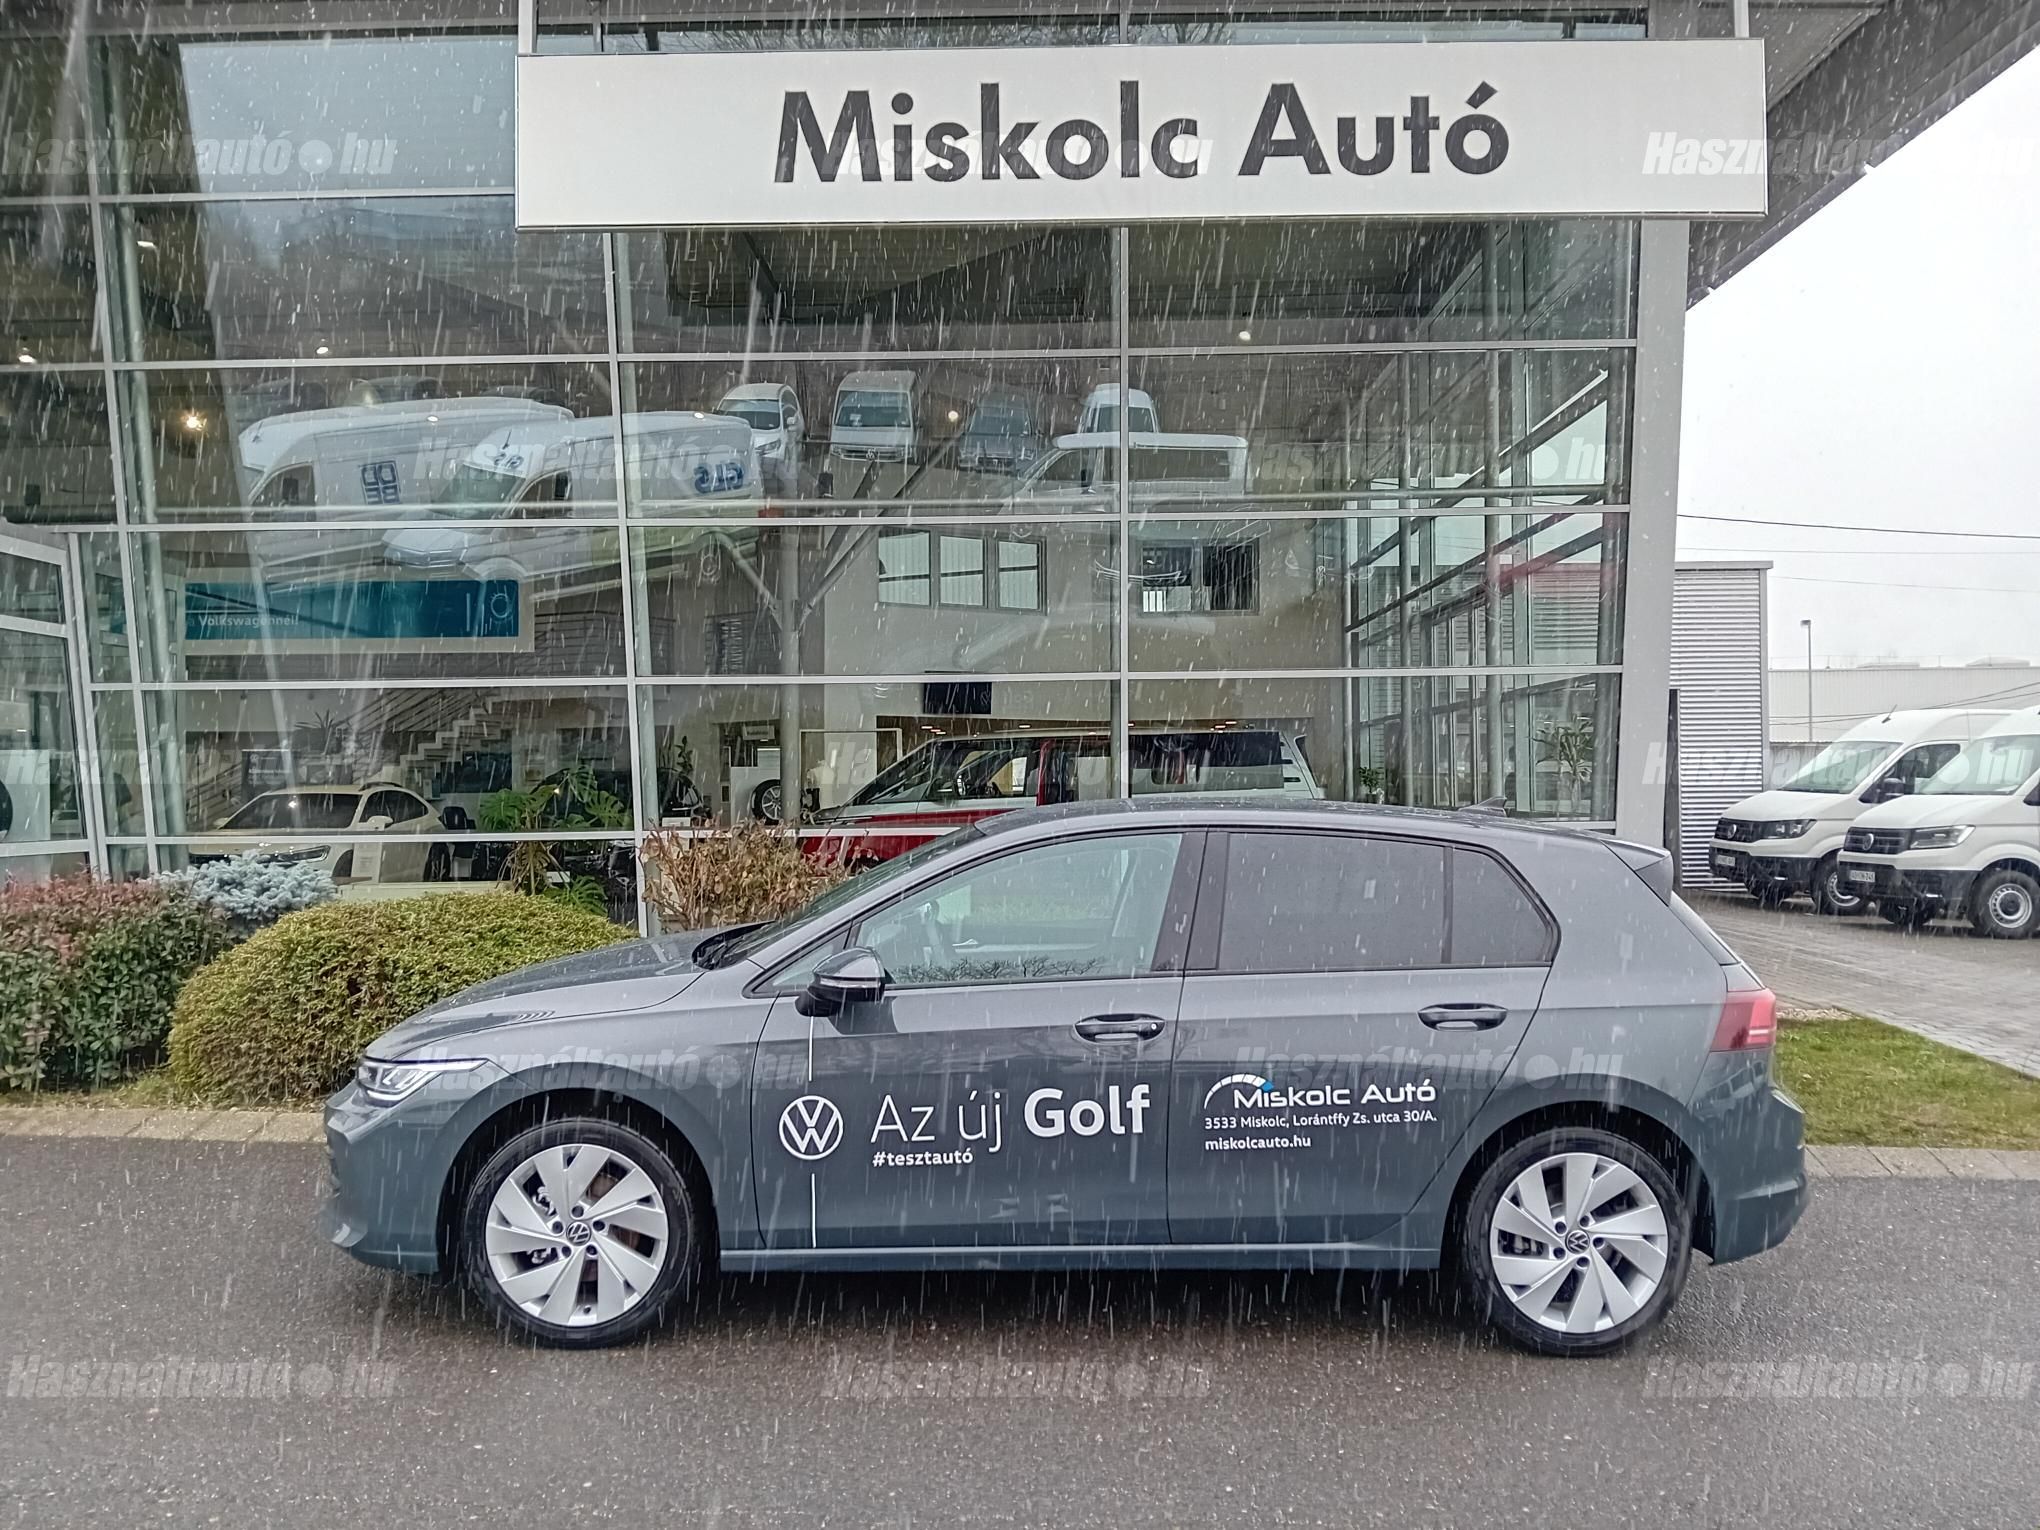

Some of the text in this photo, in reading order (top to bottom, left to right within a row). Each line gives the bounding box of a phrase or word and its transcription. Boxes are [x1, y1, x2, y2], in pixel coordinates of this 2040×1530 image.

[774, 80, 1510, 183] Miskolc Autó
[1233, 1079, 1437, 1109] Miskolc Autó
[870, 1084, 1151, 1153] Az új Golf
[1204, 1109, 1438, 1129] 3533 Miskolc, Lorántffy Zs. utca 30/A.
[1204, 1134, 1312, 1151] miskolcauto.hu
[872, 1147, 974, 1168] #tesztautó
